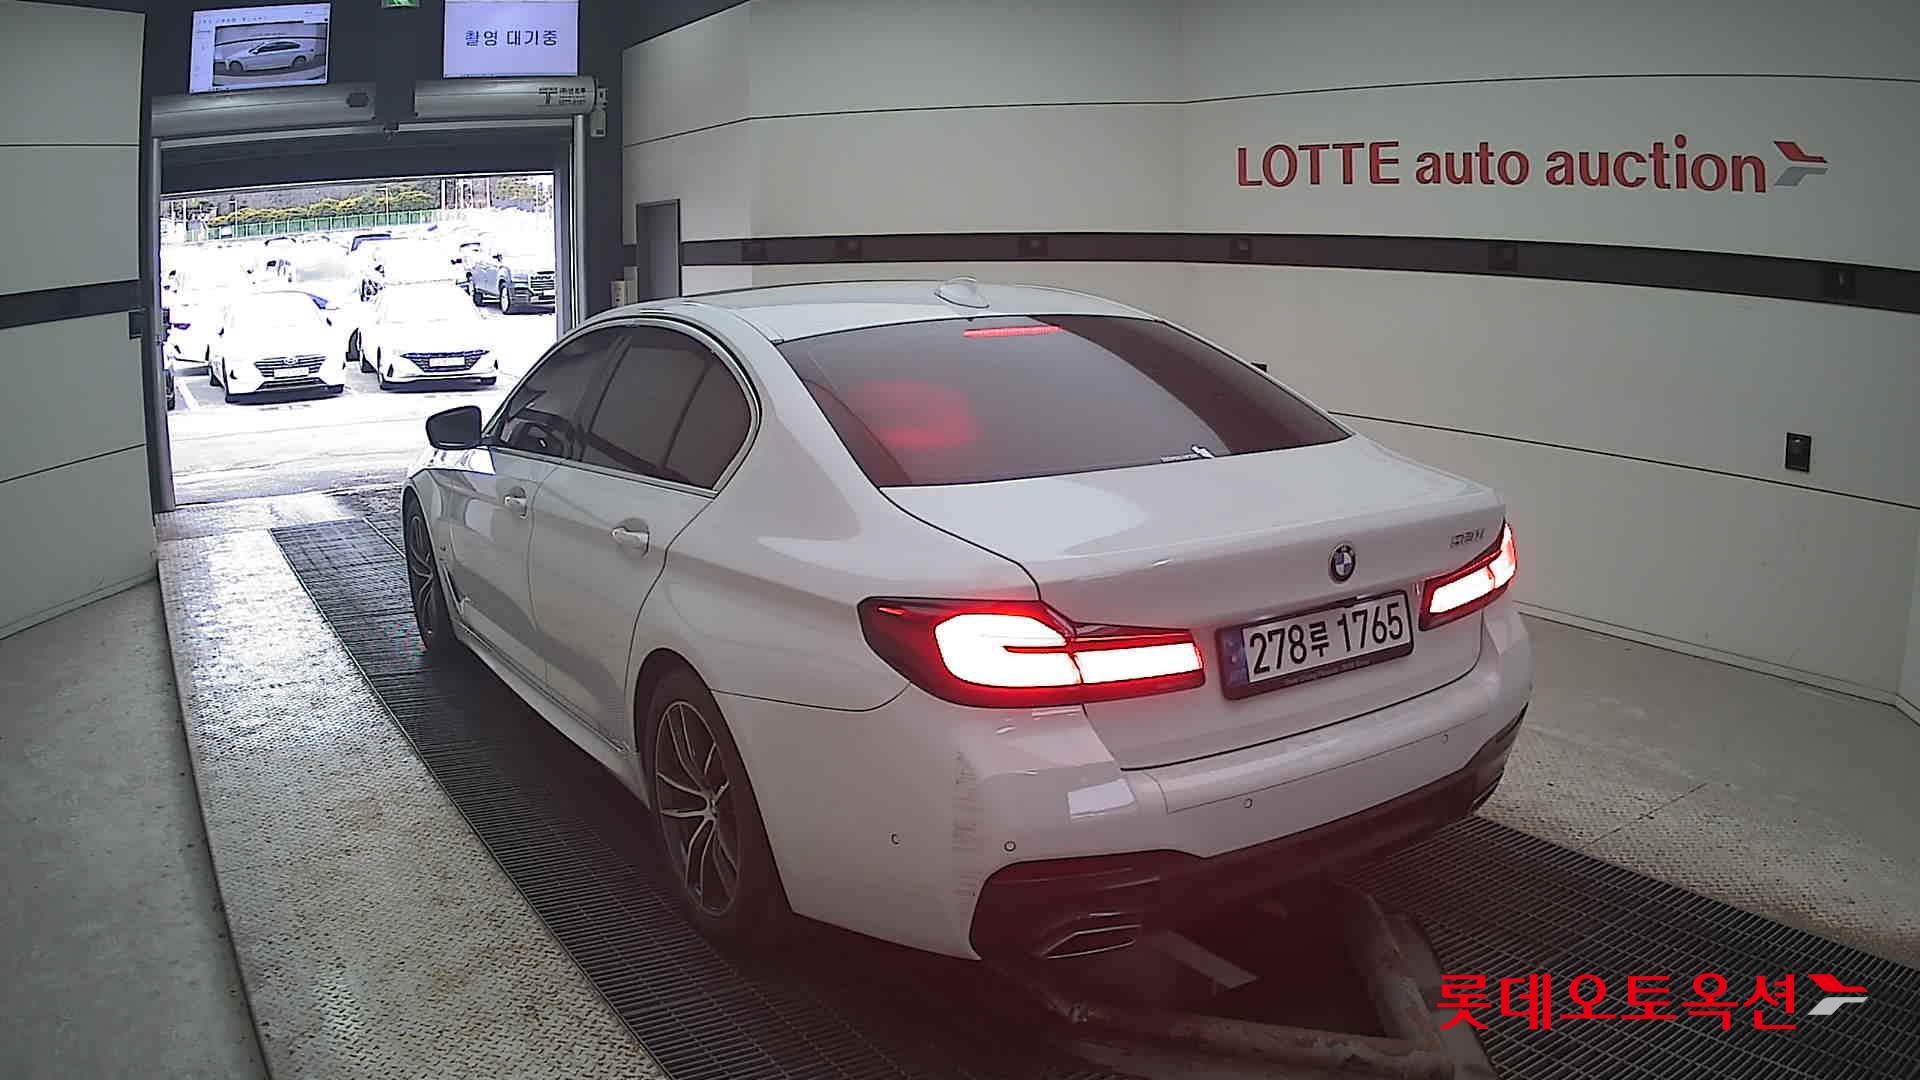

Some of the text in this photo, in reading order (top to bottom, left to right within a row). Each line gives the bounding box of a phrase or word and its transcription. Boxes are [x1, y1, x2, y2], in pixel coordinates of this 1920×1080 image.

[465, 30, 558, 47] 촬영 대기중
[1237, 135, 1768, 193] LOTTE auto auction
[1249, 620, 1330, 675] 278루
[1337, 602, 1404, 652] 1765
